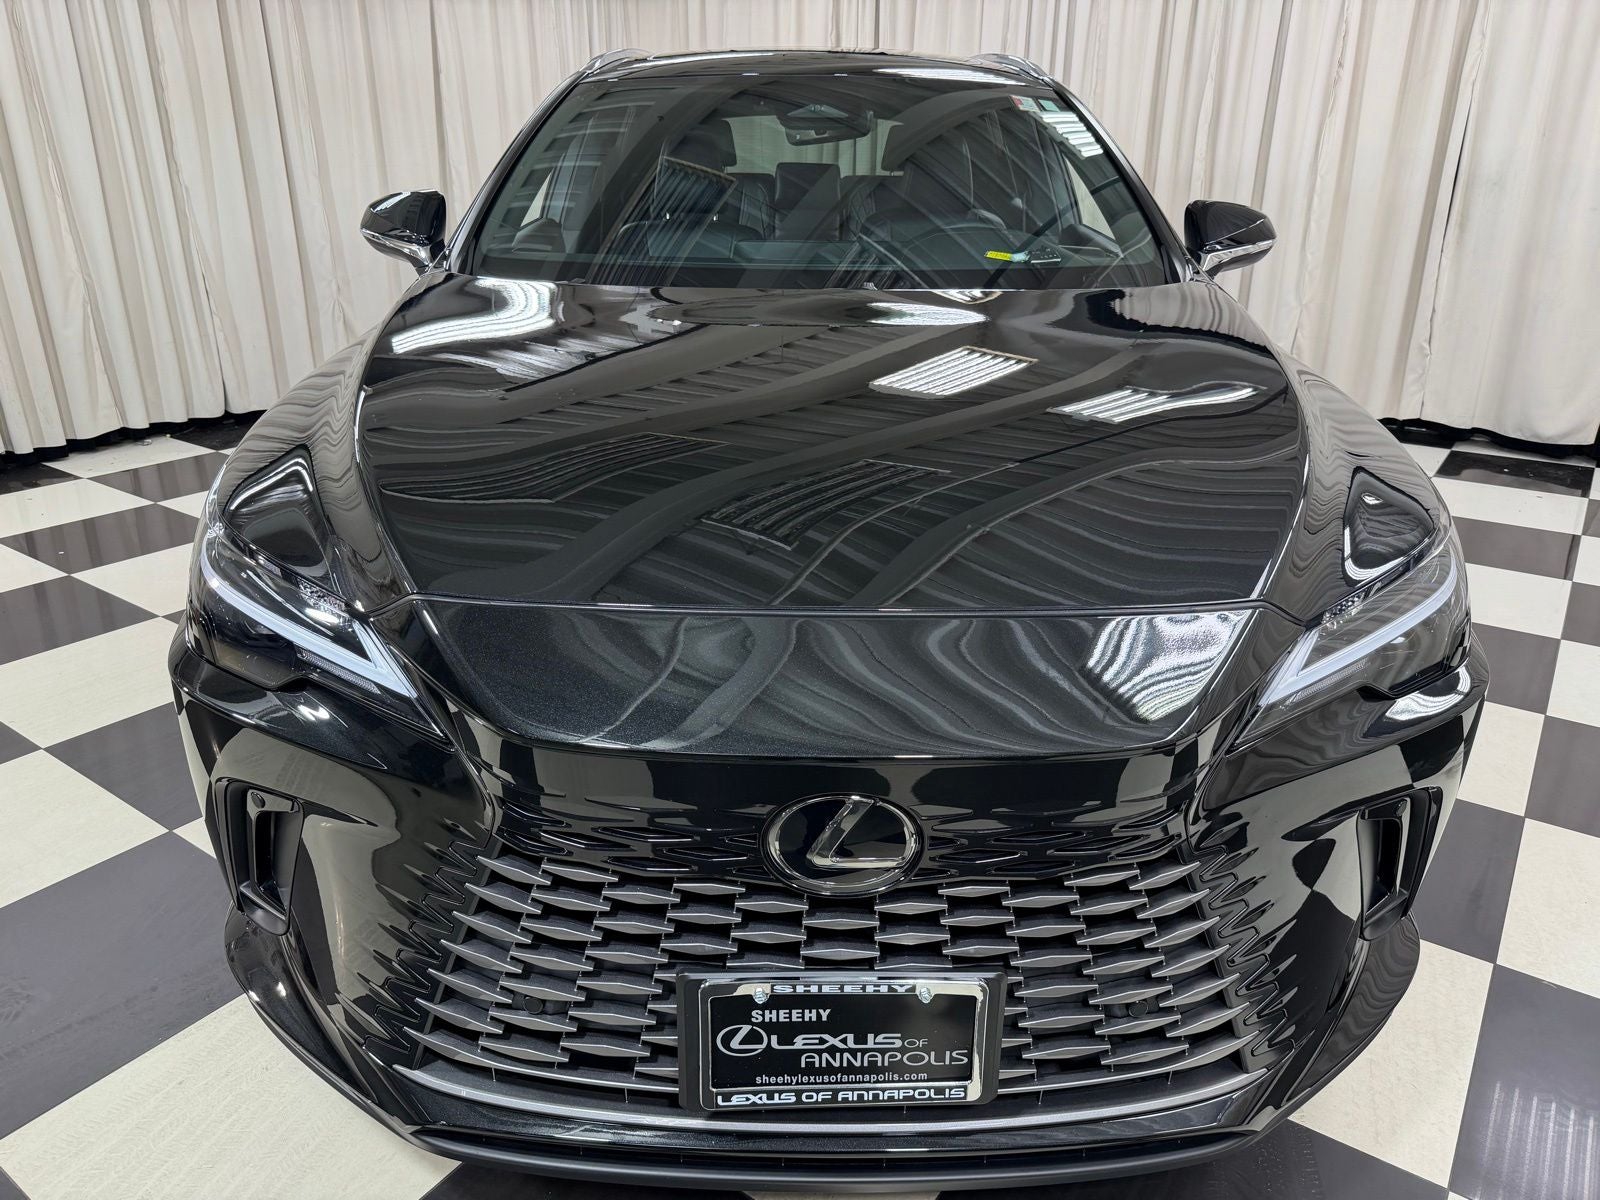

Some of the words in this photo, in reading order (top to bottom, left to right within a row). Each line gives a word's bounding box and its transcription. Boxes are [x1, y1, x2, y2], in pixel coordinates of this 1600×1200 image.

[773, 984, 912, 993] SHEEHY
[751, 1009, 831, 1023] SHEEHY
[770, 1033, 903, 1050] LEXUS
[904, 1038, 928, 1048] OF
[801, 1050, 969, 1068] ANNAPOLIS
[755, 1072, 928, 1085] sheehylexusofannapolis.com
[717, 1092, 797, 1106] LEXUS
[801, 1091, 833, 1103] OF
[837, 1088, 965, 1102] ANNAPOLIS
